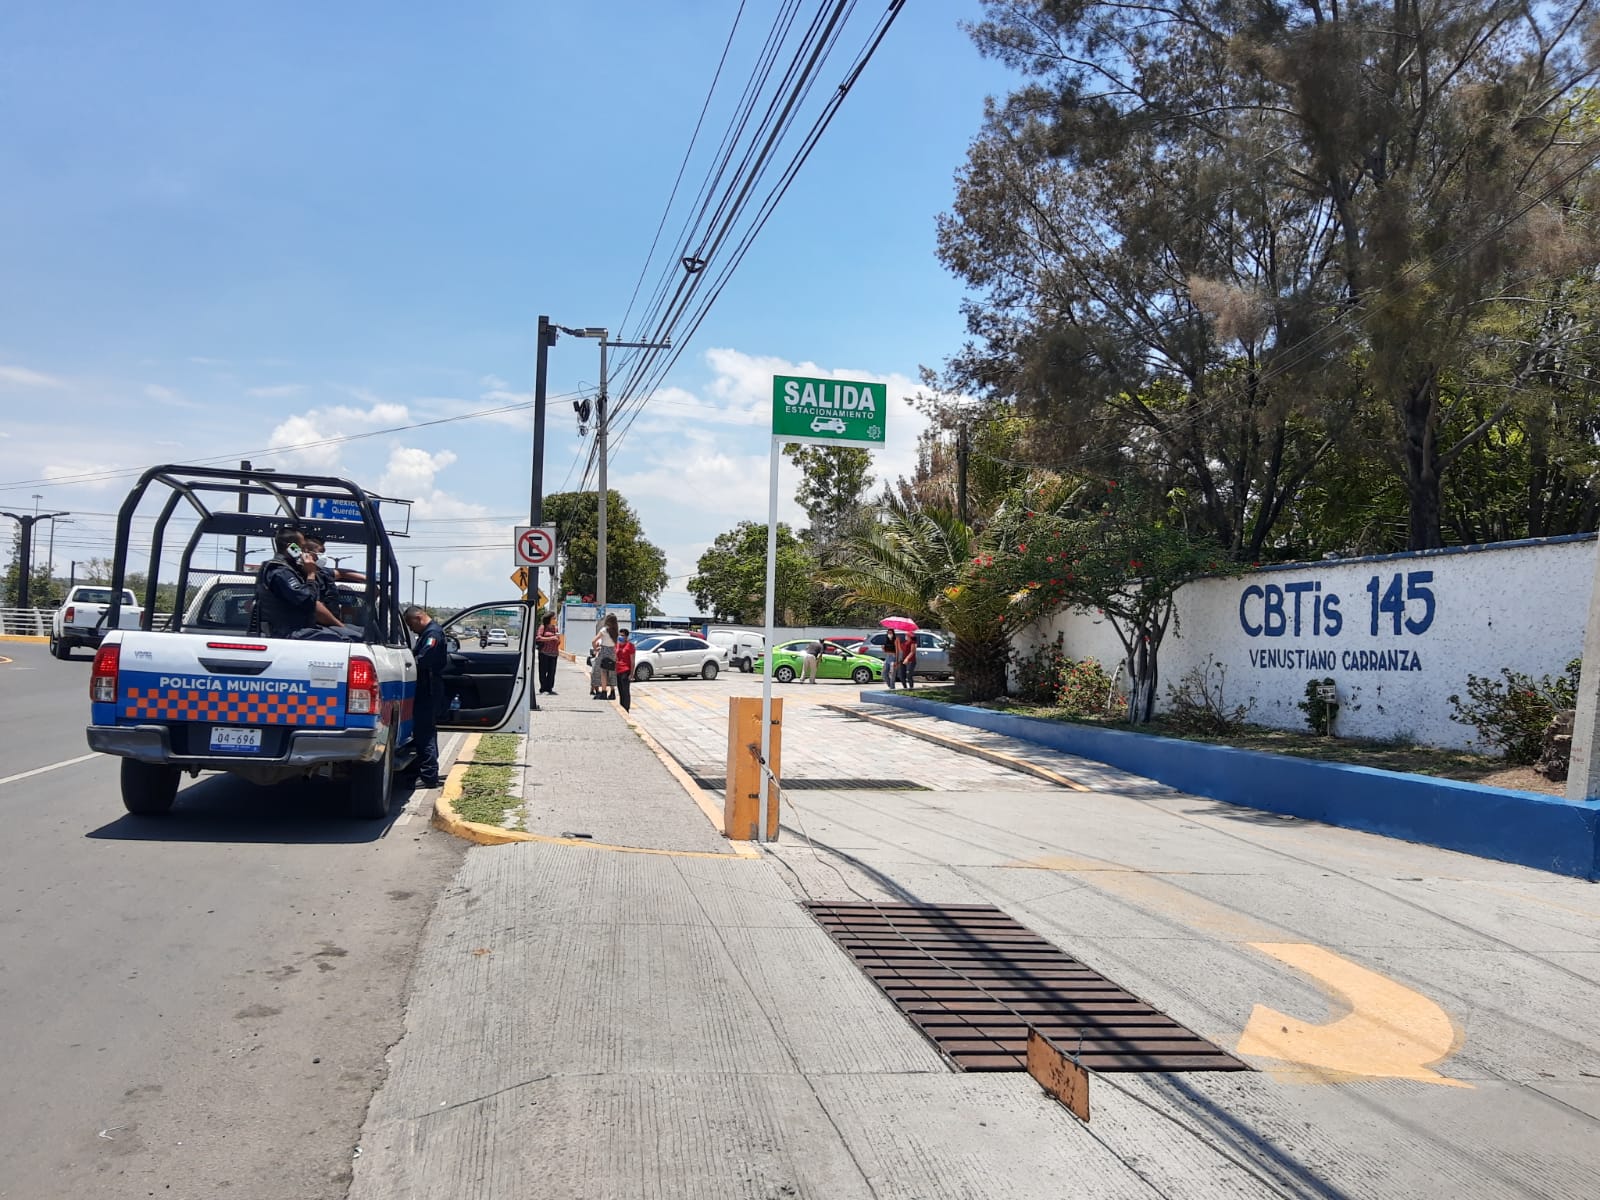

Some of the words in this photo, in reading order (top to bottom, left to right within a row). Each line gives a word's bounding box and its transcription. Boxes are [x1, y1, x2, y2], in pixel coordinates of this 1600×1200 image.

[784, 381, 876, 411] SALIDA
[785, 406, 874, 419] ESTACIONAMIENTO
[1239, 581, 1343, 637] CBTis
[1366, 571, 1436, 636] 145
[1249, 649, 1336, 671] VENUSTIANO
[1342, 649, 1422, 671] CARRANZA
[159, 676, 223, 691] POLICÍA
[227, 679, 308, 694] MUNICIPAL
[217, 733, 255, 745] 04-696
